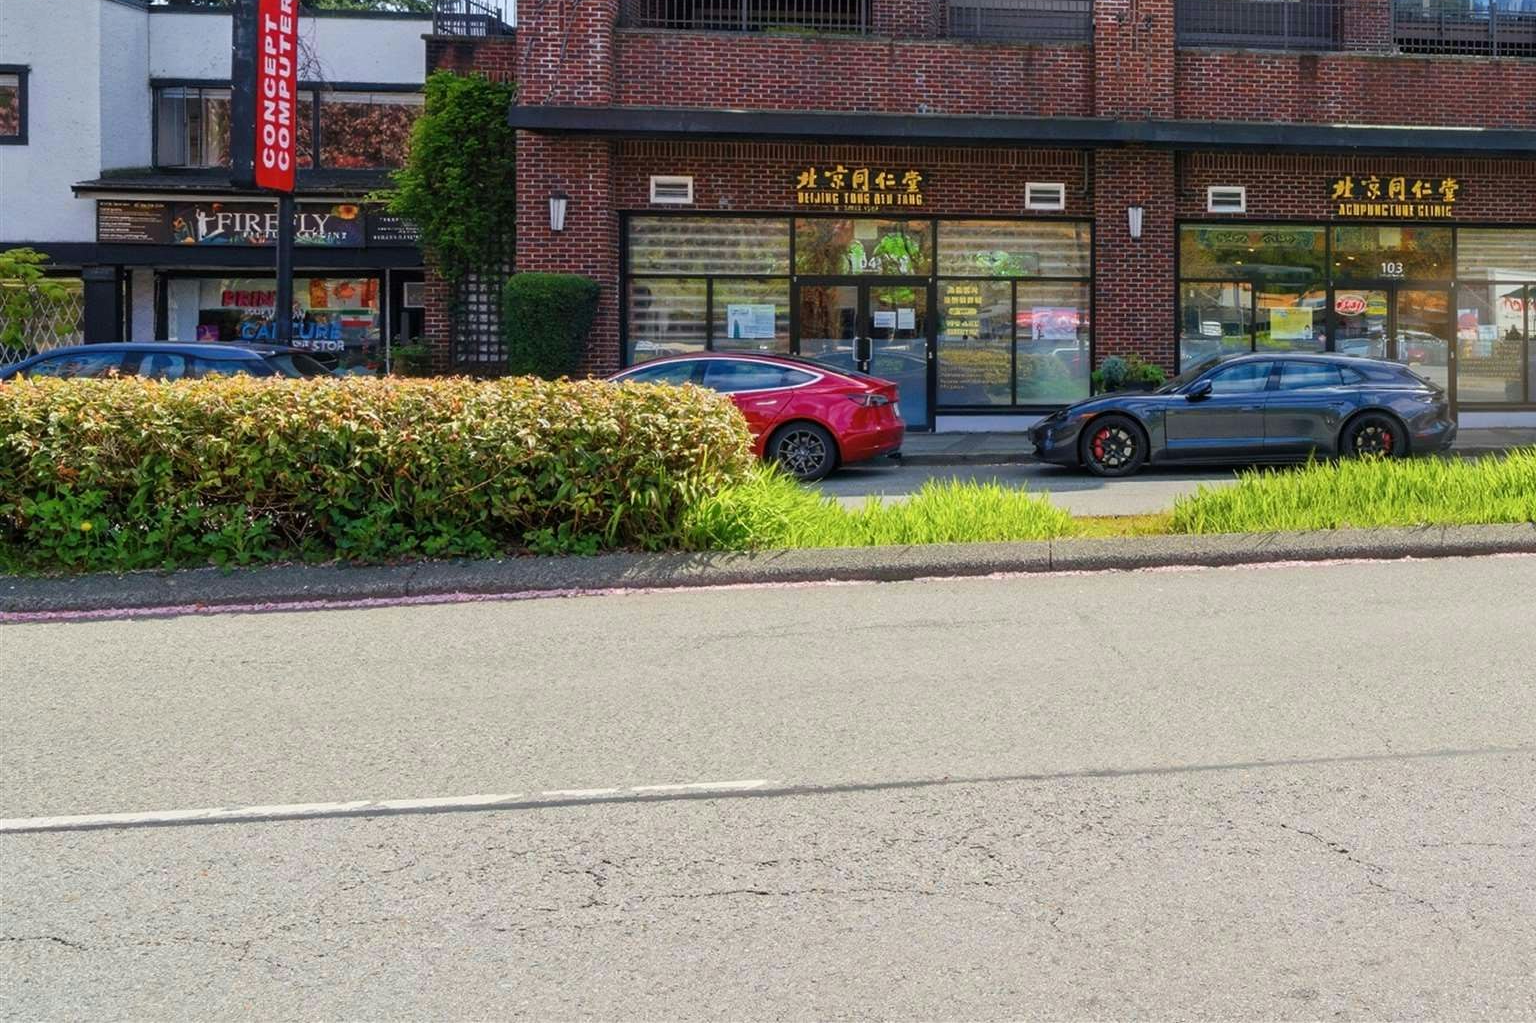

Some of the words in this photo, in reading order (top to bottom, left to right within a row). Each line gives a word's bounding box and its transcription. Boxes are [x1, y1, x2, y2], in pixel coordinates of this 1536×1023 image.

[263, 14, 278, 169] CONCEPT
[796, 165, 922, 192] 北京同仁堂
[1331, 175, 1459, 202] 北京同仁堂
[797, 192, 839, 205] BEIJING
[844, 192, 870, 205] TONG
[897, 193, 923, 206] TANG
[1338, 203, 1414, 217] ACUPUNCTURE
[1417, 204, 1453, 217] CLINIC
[216, 212, 332, 235] FIRELY
[1381, 262, 1404, 274] 103
